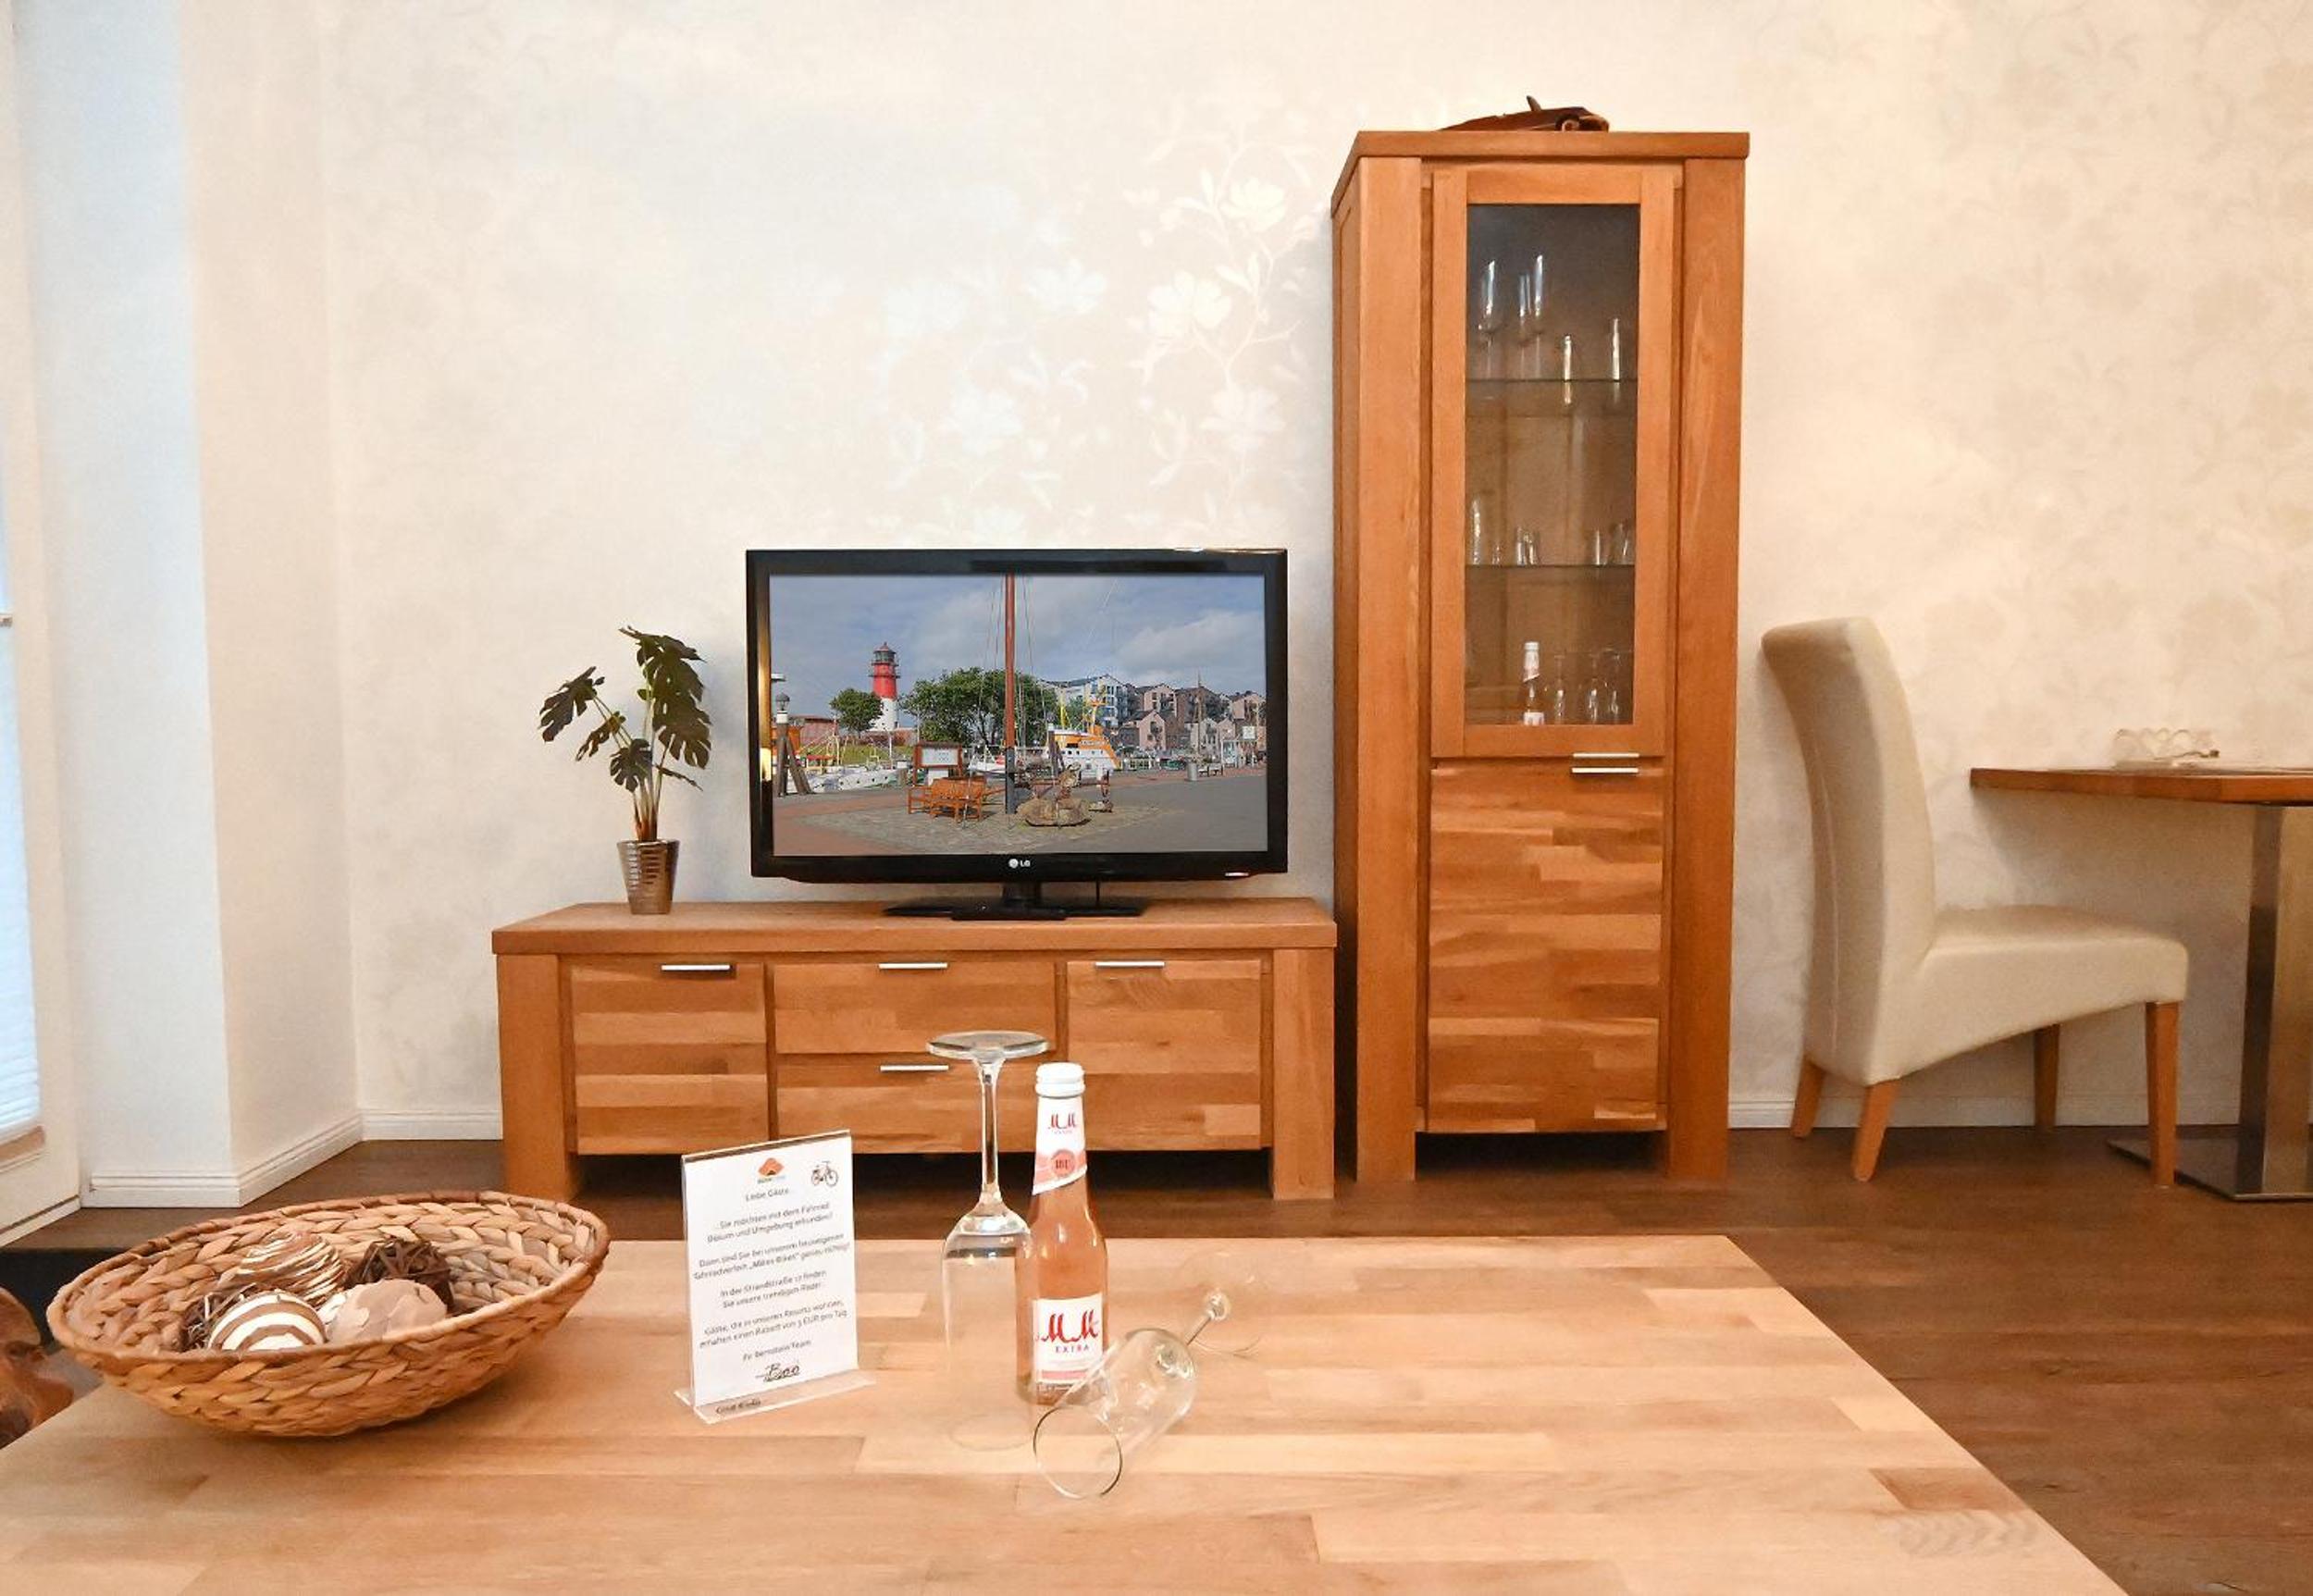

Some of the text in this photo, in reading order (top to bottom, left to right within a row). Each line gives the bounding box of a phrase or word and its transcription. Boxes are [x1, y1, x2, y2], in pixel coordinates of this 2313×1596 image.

[783, 1208, 800, 1218] dem
[735, 1228, 750, 1238] und
[1056, 1344, 1090, 1354] EXTRA
